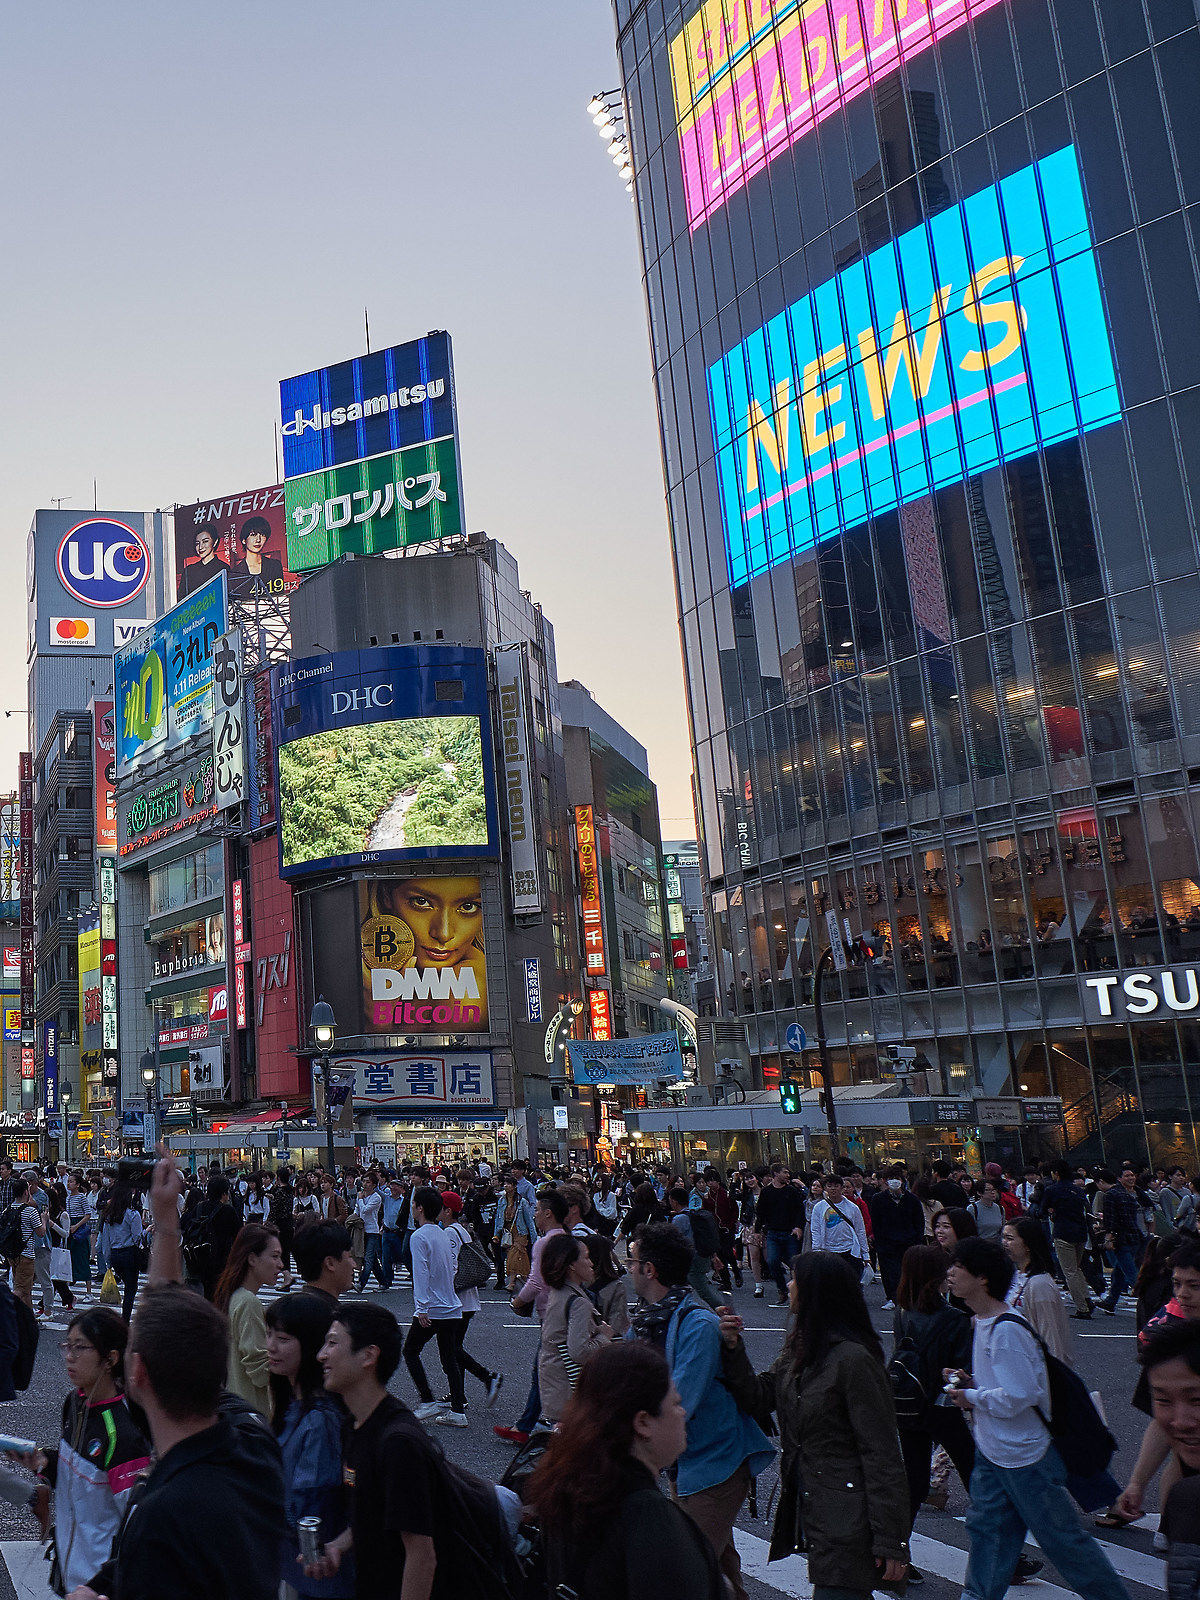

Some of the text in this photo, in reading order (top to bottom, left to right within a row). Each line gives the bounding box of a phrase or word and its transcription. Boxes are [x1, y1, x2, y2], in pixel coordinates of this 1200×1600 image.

[745, 255, 1029, 493] NEWS
[280, 377, 445, 436] Hisamitsu
[292, 470, 447, 537] サロンパス
[278, 662, 334, 688] DHC Channel
[215, 638, 243, 798] もんじゃ
[331, 683, 394, 716] DHC
[500, 676, 527, 842] Taisei neon
[360, 852, 380, 862] DHC
[578, 808, 604, 969] クスリのことなら 三千里
[154, 950, 205, 976] Euphoria
[370, 966, 481, 1001] DMM
[372, 1001, 481, 1025] Bitcoin
[526, 961, 541, 1020] 大盛堂商事ビル
[47, 1028, 55, 1057] MIZUHO
